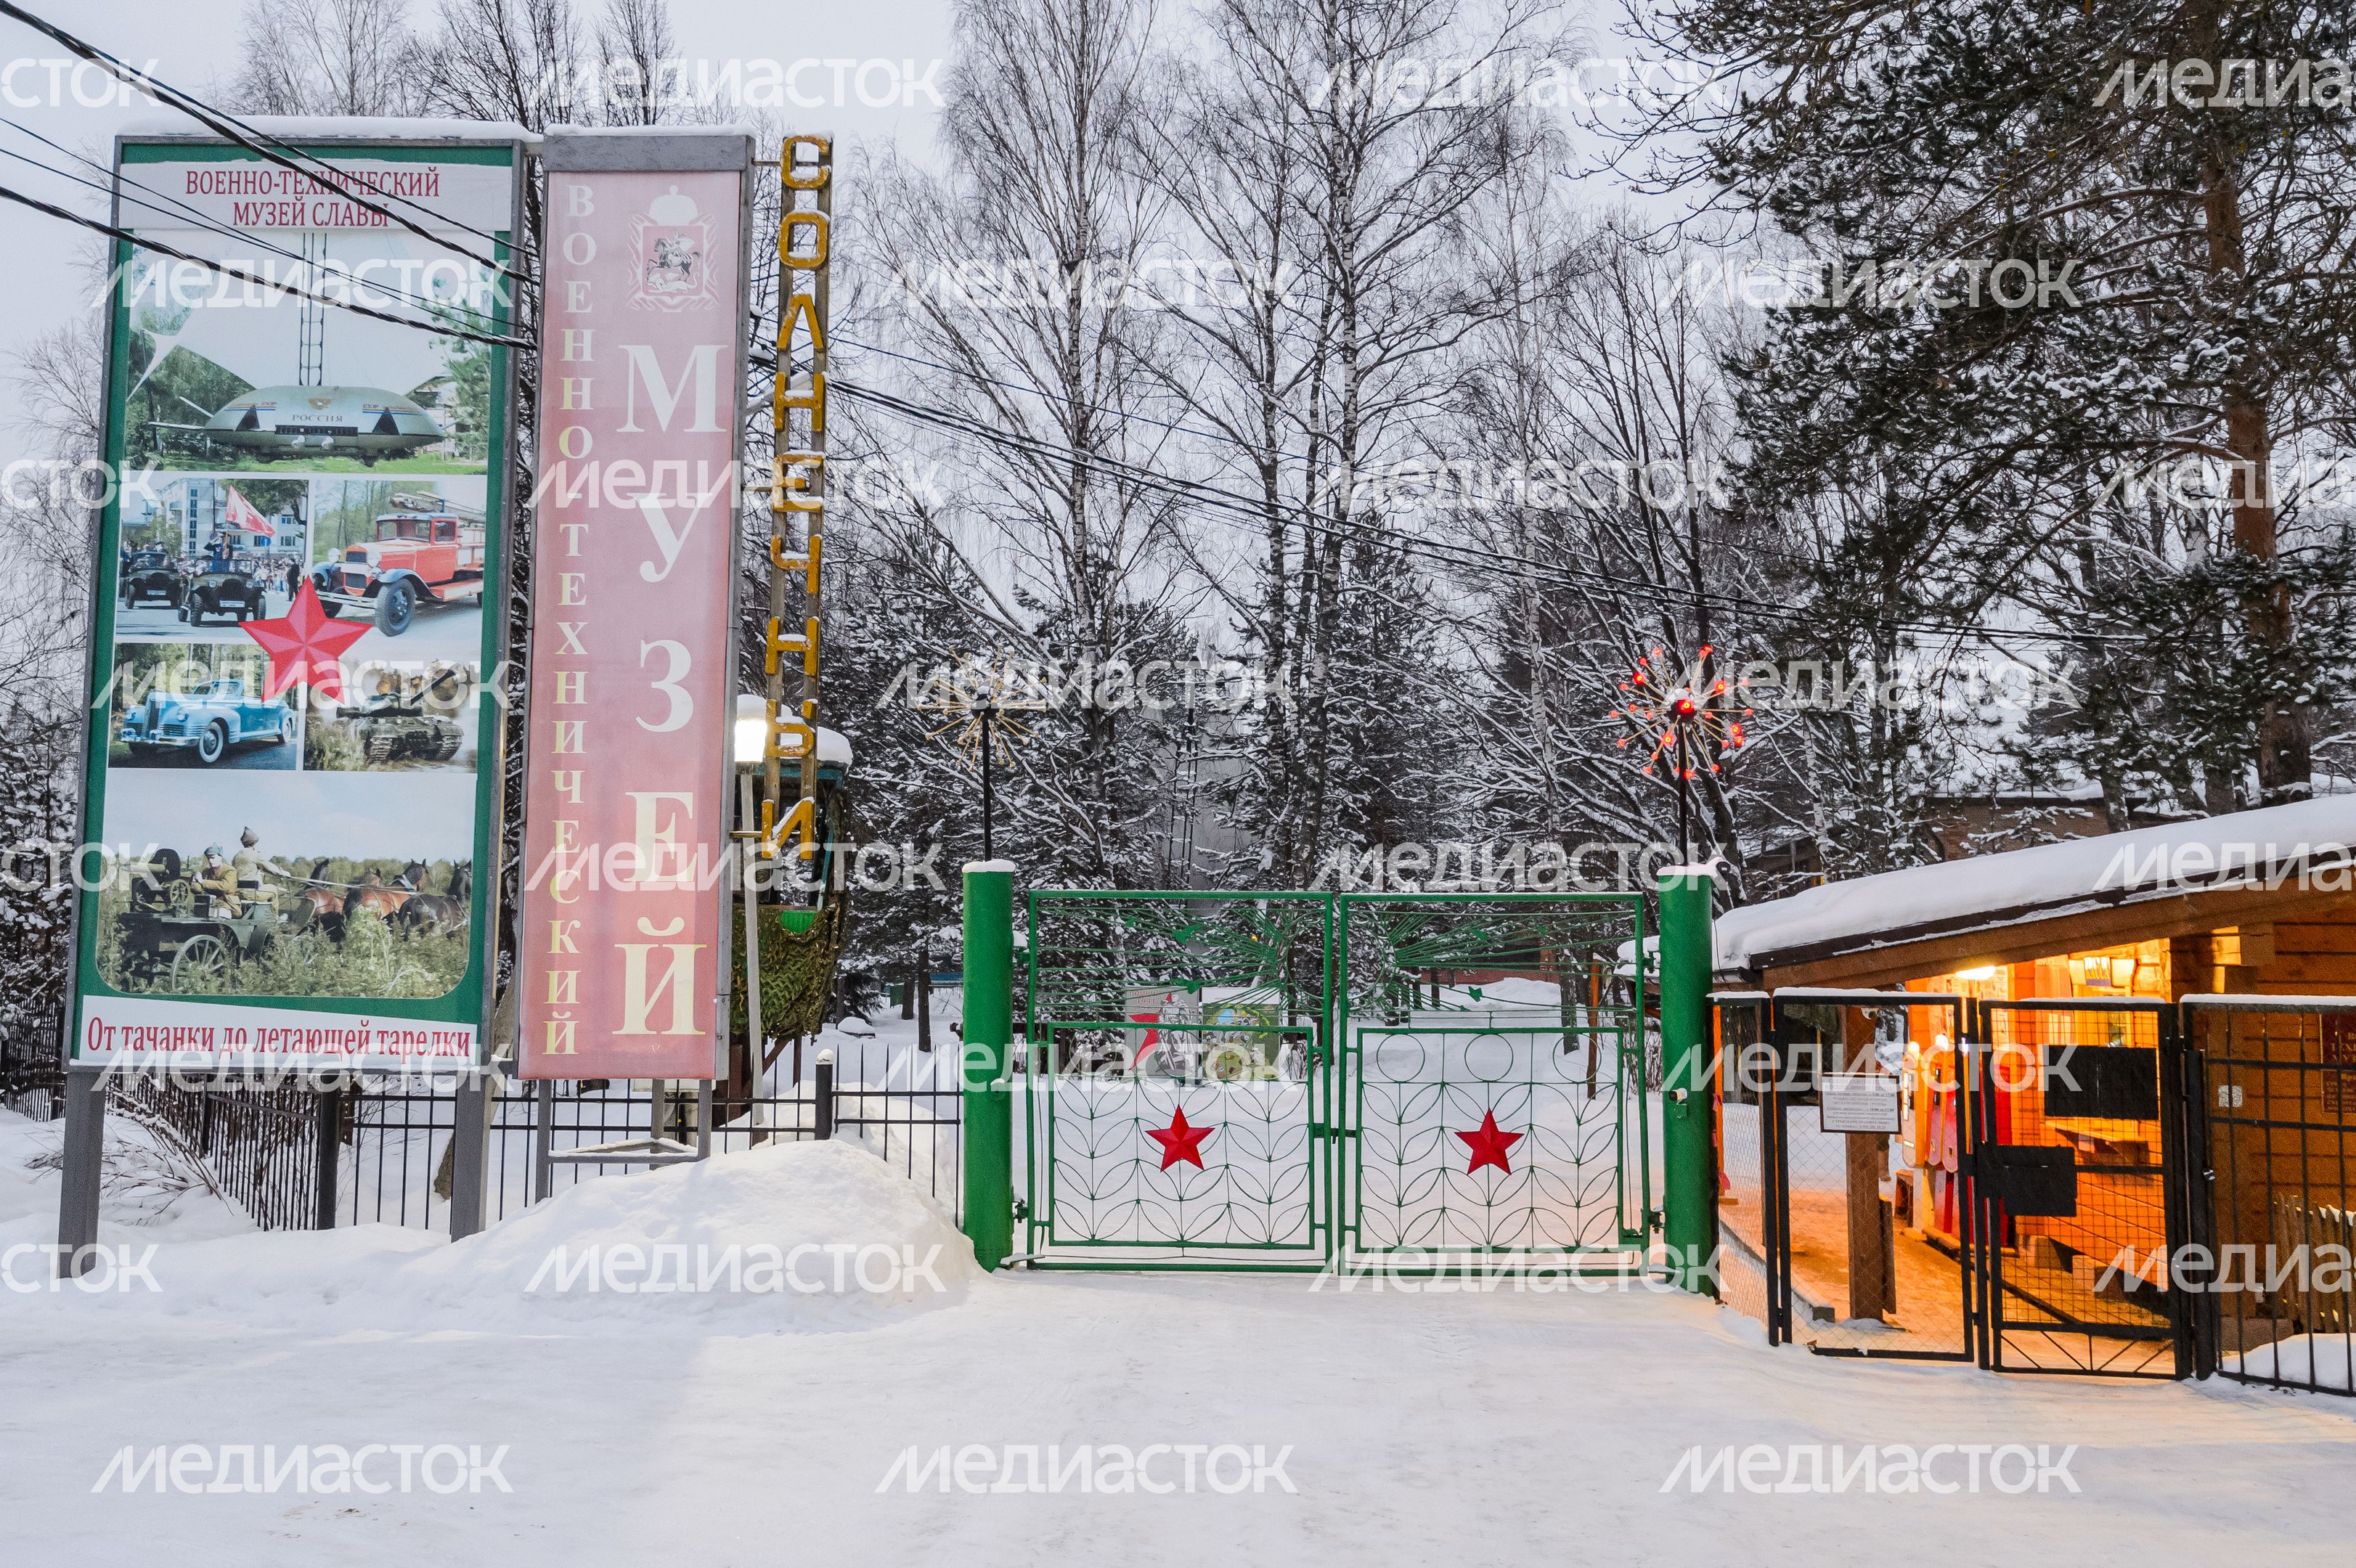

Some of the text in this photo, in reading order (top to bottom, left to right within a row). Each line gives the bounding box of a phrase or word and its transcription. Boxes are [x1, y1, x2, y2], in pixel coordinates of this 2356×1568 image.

[186, 166, 439, 197] ВОЕННО-ТЕХНИЧЕСКИЙ
[232, 196, 389, 227] МУЗЕЙ СЛАВЫ
[88, 1016, 470, 1065] От тачанки до летающей тарелки
